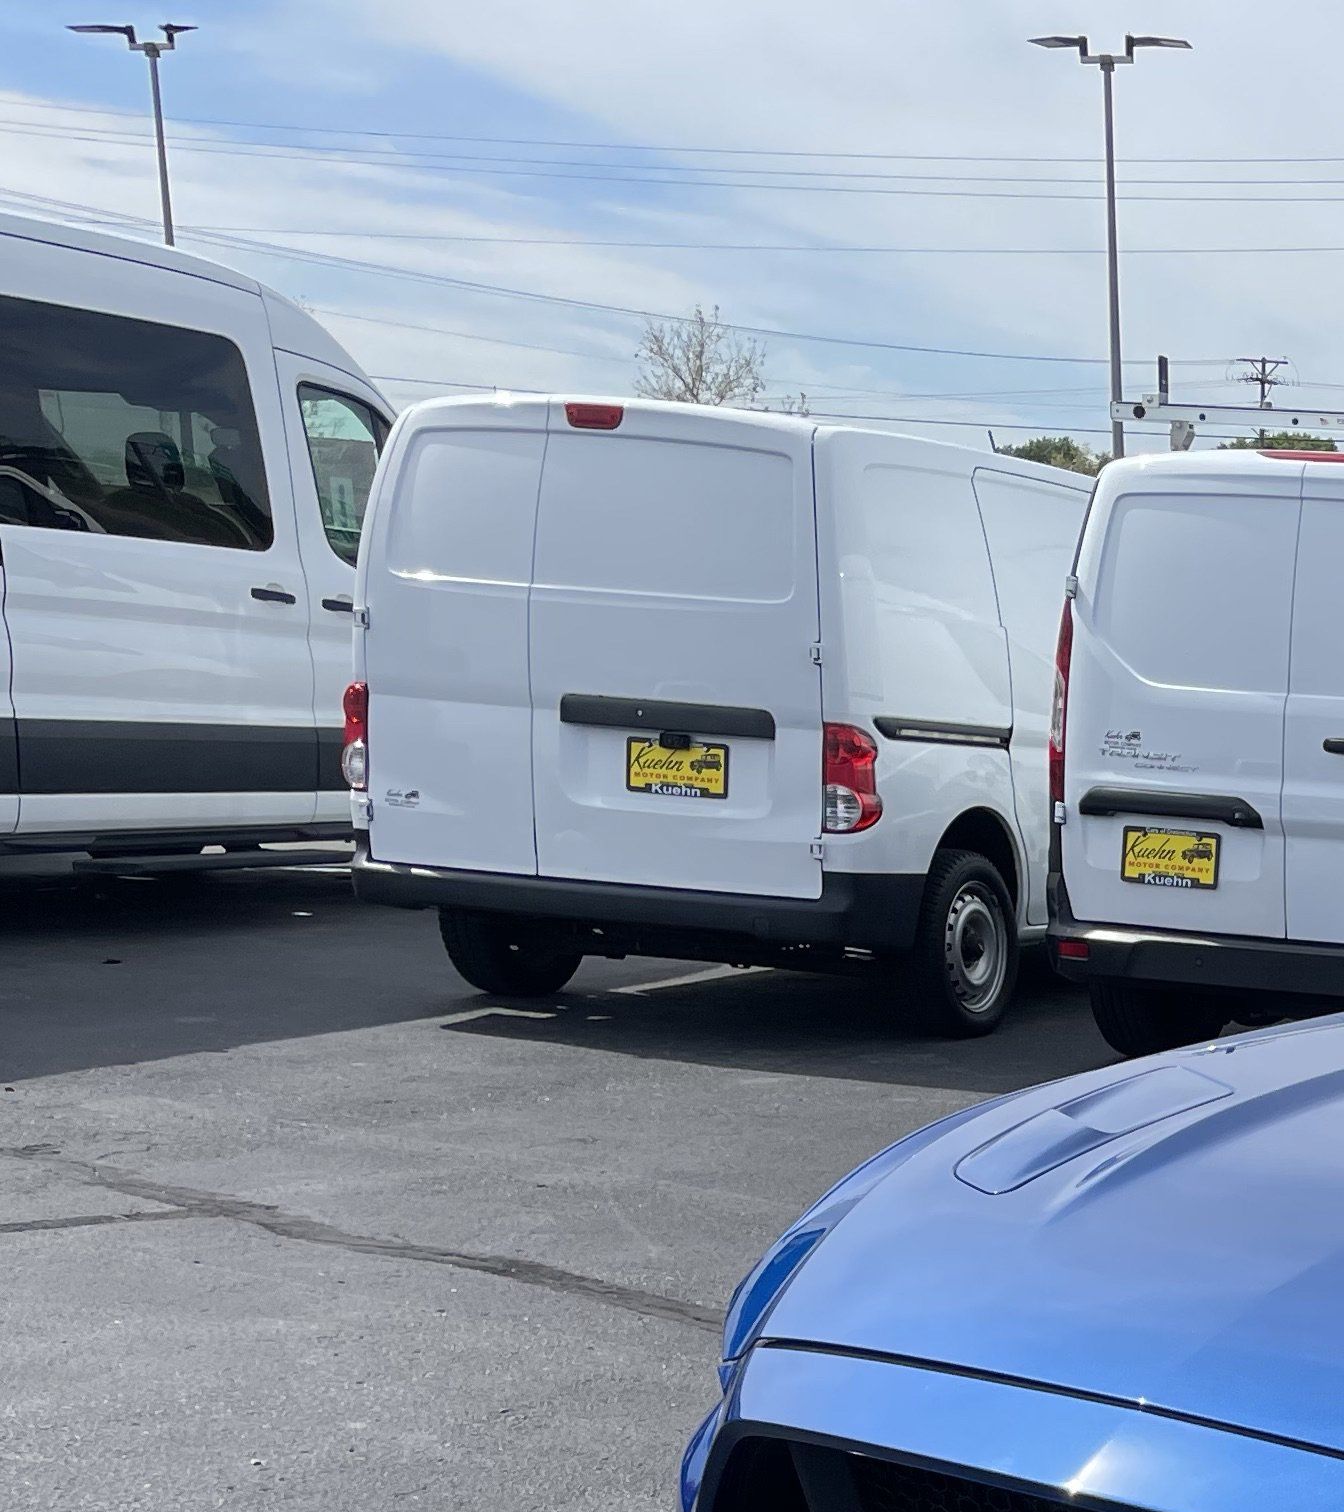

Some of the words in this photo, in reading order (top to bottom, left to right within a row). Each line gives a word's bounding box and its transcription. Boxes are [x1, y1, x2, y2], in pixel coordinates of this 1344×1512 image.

[630, 747, 684, 772] Kuehn
[633, 771, 669, 780] MOTOR
[672, 774, 720, 785] COMPANY
[650, 783, 701, 798] Kuehn
[1124, 835, 1178, 862] Kuehn
[1128, 860, 1162, 870] MOTOR
[1163, 864, 1211, 874] COMPANY
[1144, 873, 1192, 888] Kuehn
